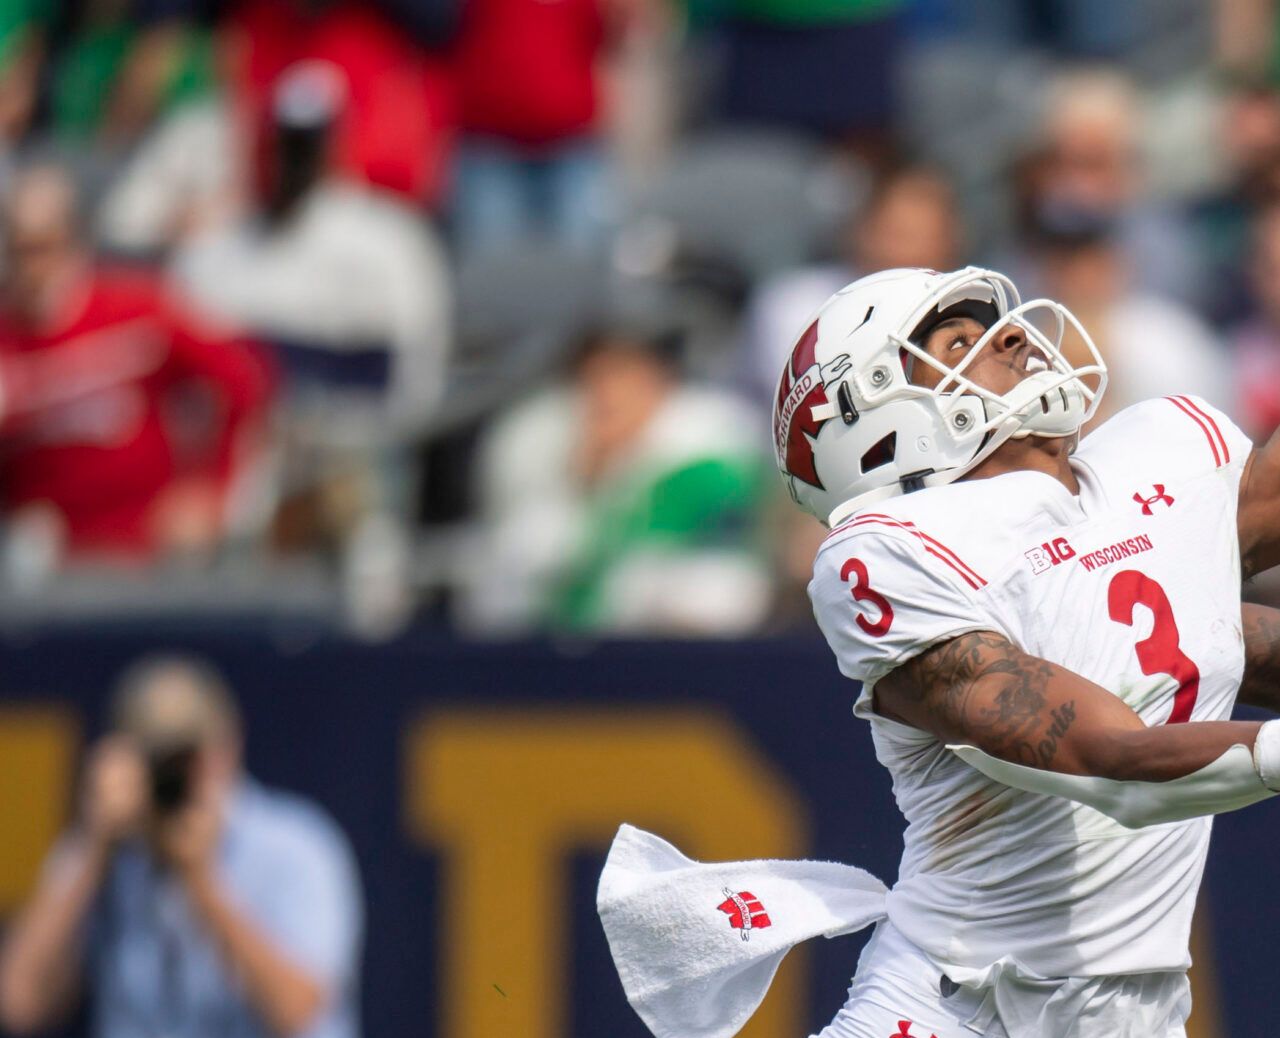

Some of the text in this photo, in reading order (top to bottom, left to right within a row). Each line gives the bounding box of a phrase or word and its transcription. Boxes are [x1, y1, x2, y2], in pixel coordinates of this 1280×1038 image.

[1079, 534, 1154, 572] WISCONSIN
[841, 557, 894, 637] 3
[1107, 569, 1200, 725] 3
